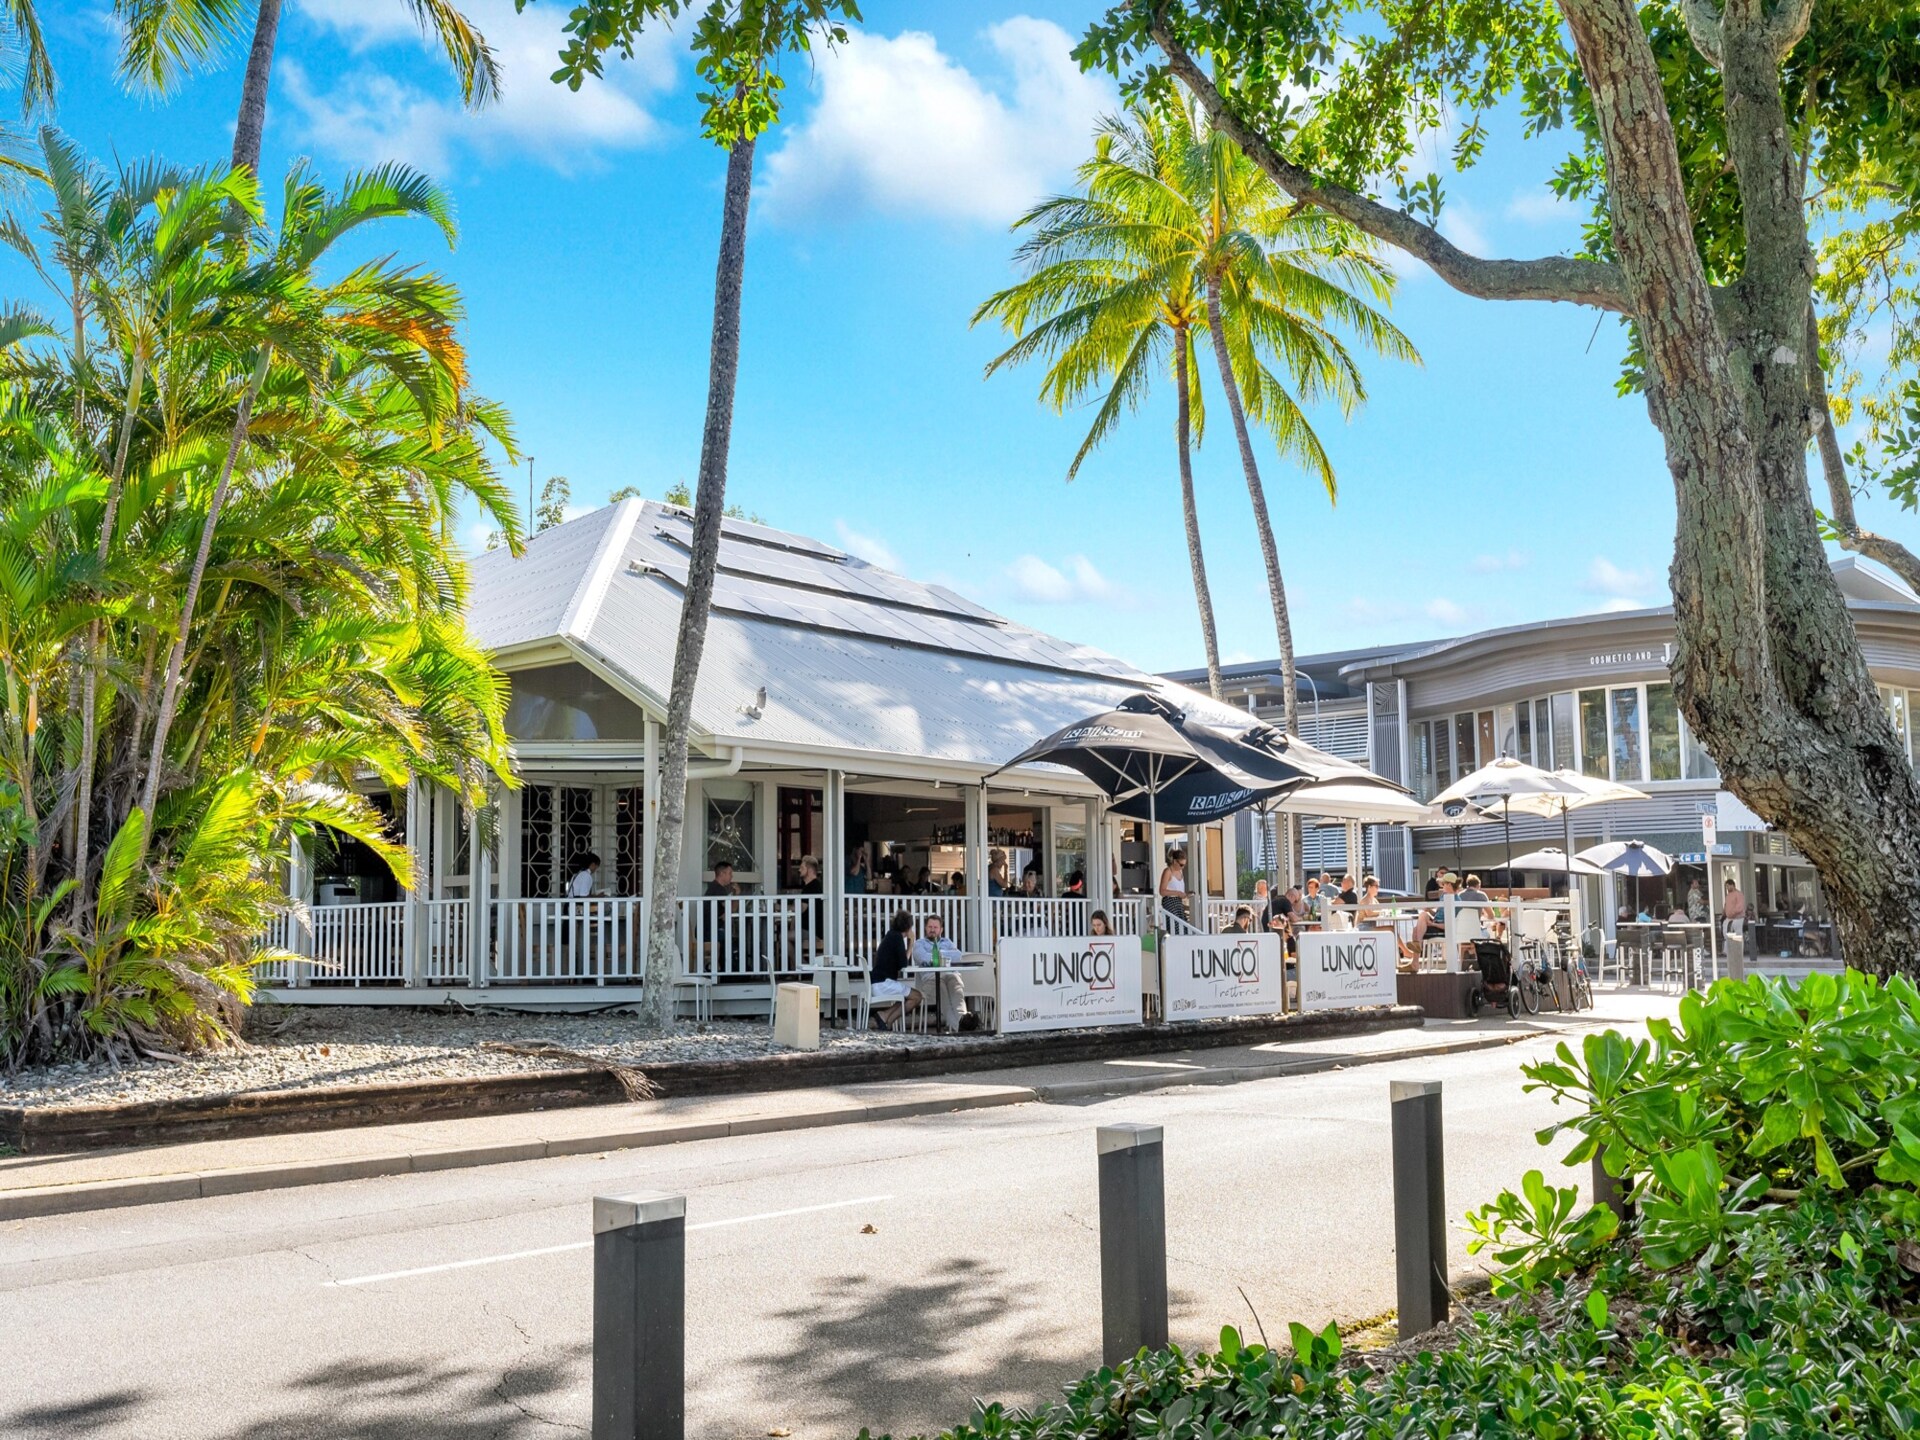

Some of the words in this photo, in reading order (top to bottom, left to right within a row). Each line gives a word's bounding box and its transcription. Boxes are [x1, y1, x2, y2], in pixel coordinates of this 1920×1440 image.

[1590, 653, 1632, 665] COSMETIC
[1635, 651, 1651, 660] AND
[1032, 950, 1112, 985] L'UNICO
[1192, 947, 1256, 978] L'UNICO
[1321, 944, 1375, 972] L'UNICO
